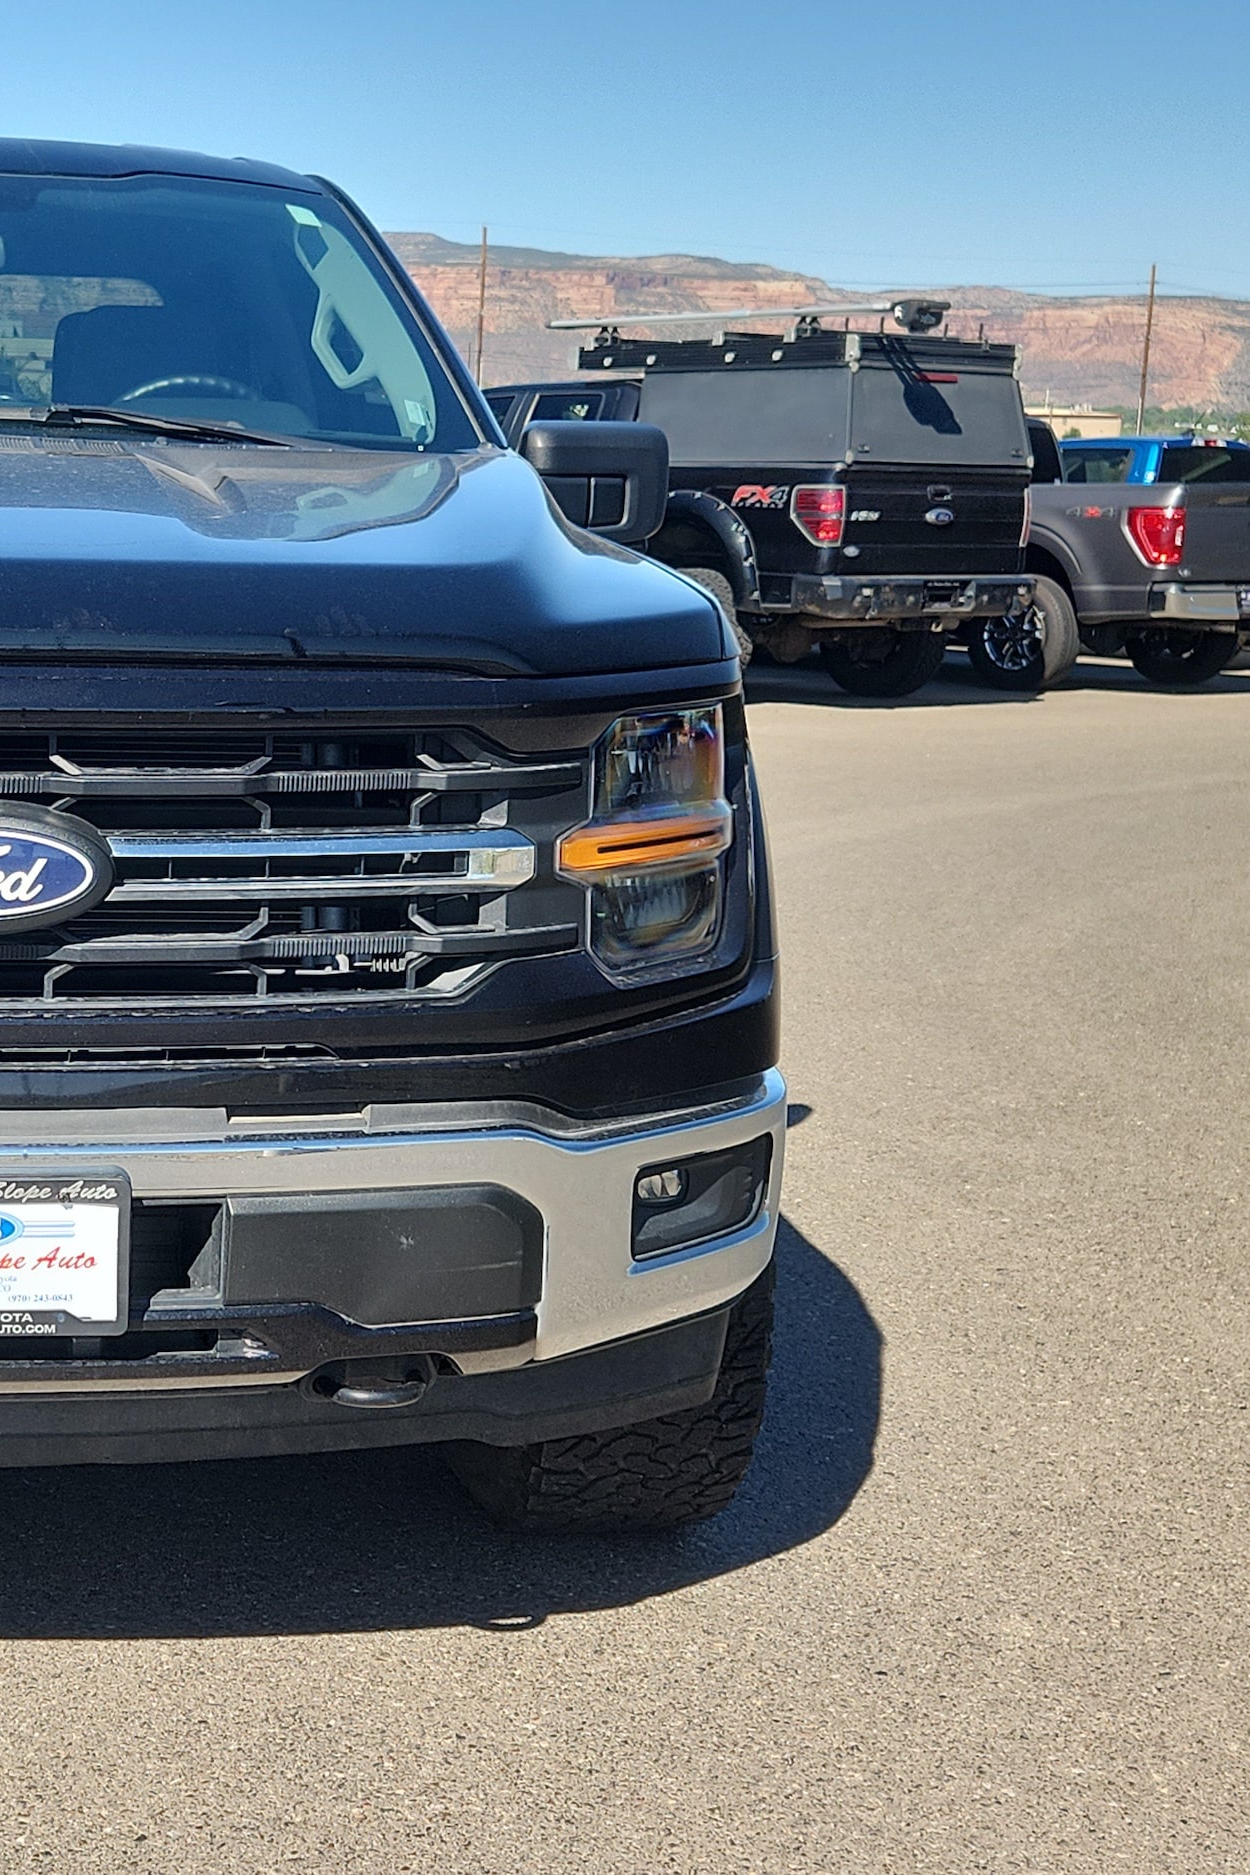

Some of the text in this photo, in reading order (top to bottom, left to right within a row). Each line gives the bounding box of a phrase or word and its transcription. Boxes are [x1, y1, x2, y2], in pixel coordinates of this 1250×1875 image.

[732, 484, 790, 504] FX4
[56, 1180, 117, 1200] Auto
[31, 1246, 98, 1271] Auto
